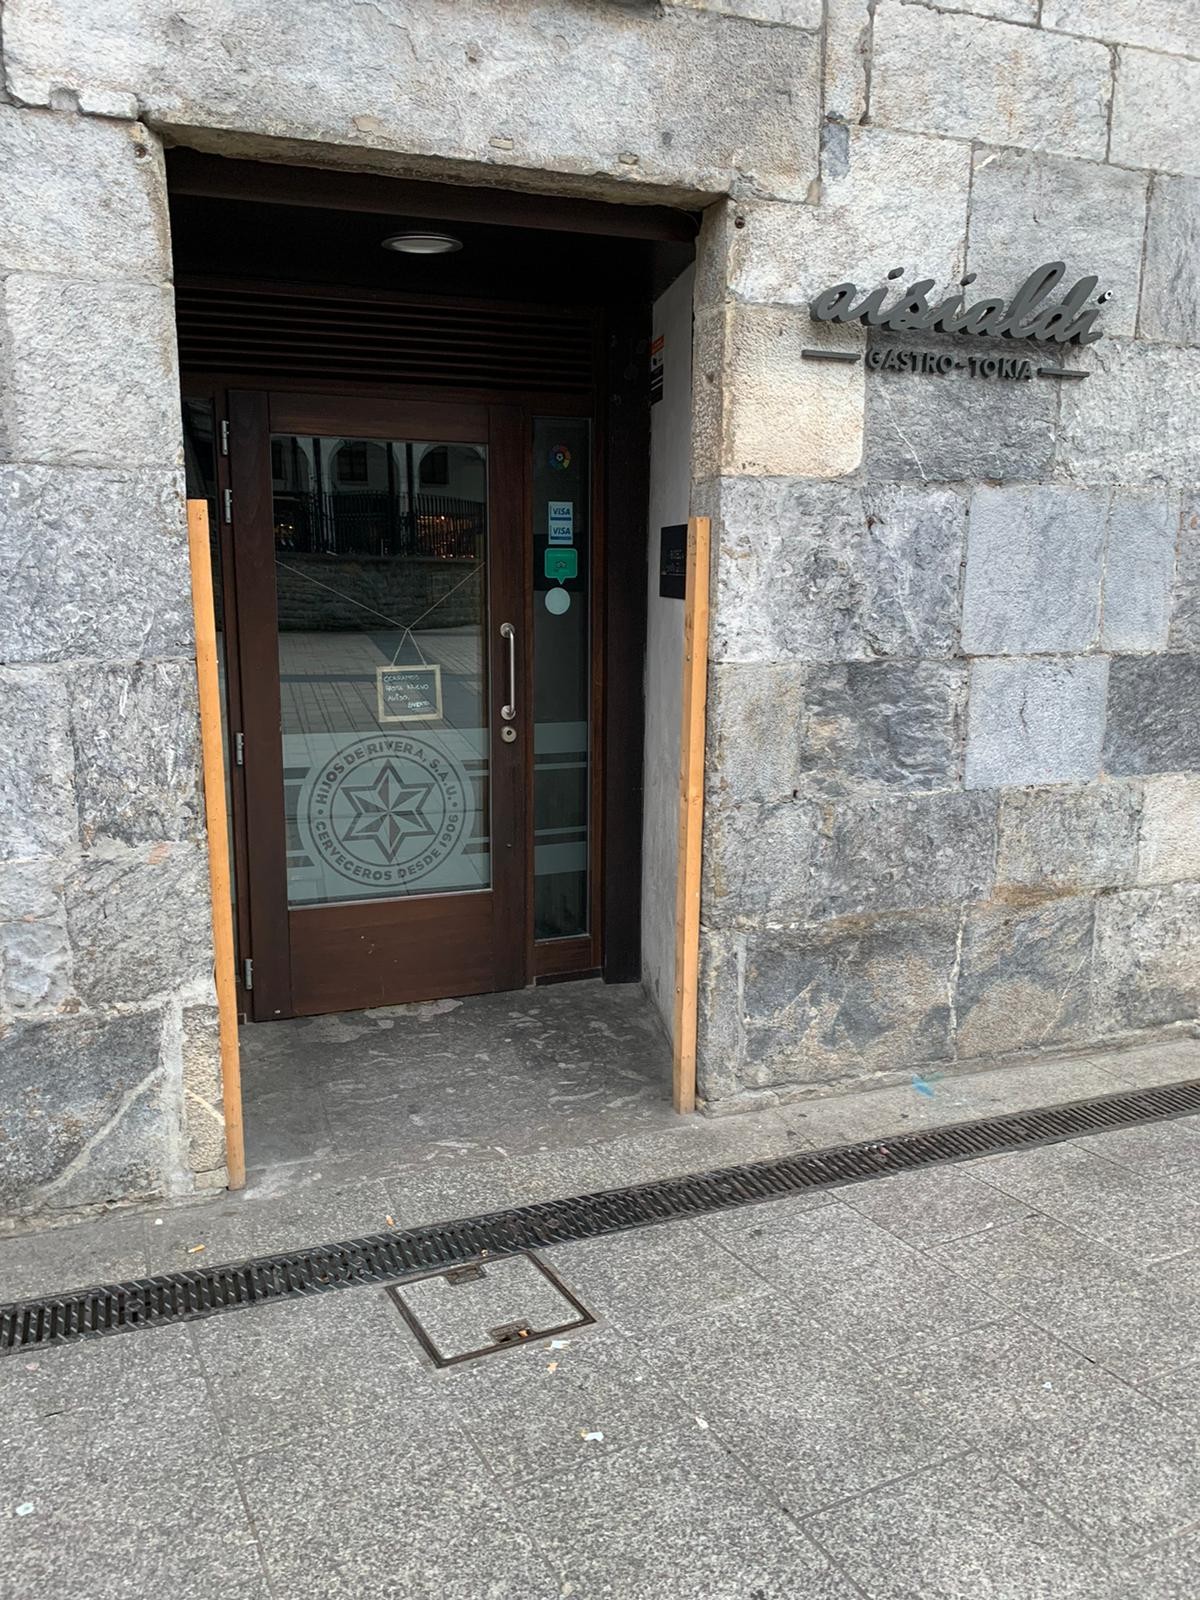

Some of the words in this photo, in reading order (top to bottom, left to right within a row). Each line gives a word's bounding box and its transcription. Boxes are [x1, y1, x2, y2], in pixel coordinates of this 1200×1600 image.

[865, 350, 1034, 381] GASTRO-TOKIA
[552, 507, 571, 516] VISA
[552, 526, 571, 535] VISA
[315, 762, 345, 805] HIJOS
[343, 747, 366, 766] DE
[367, 740, 427, 763] RIVERA,
[315, 820, 393, 881] CERVECEROS
[397, 848, 442, 878] DESDE
[439, 813, 459, 848] 1906
